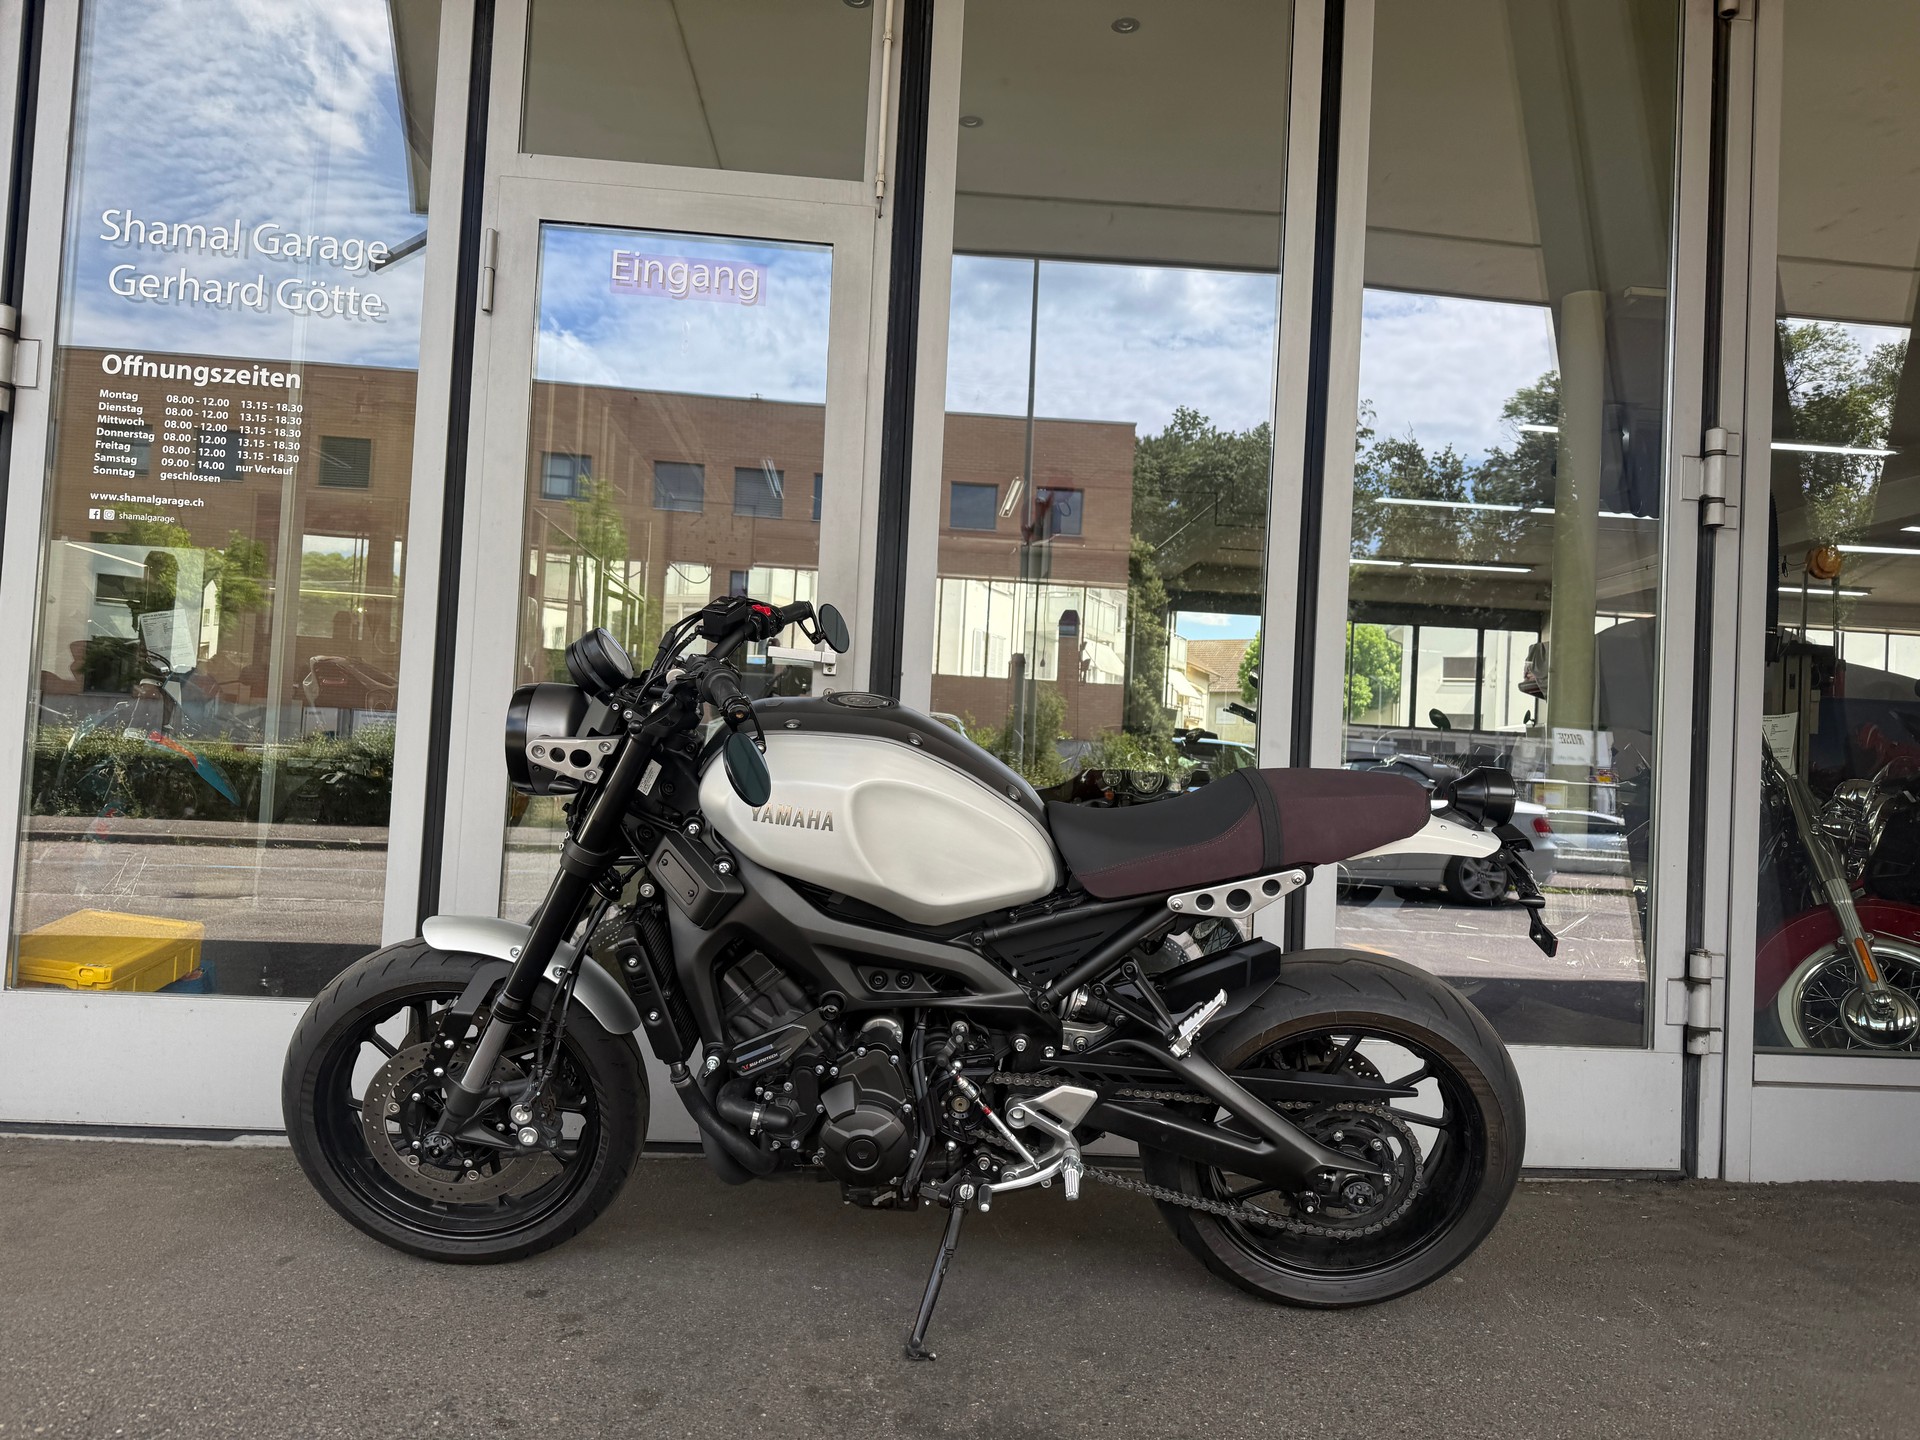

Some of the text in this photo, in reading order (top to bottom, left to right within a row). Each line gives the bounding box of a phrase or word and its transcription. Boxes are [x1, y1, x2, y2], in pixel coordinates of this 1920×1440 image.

[100, 209, 389, 271] Shamal Garage
[612, 249, 759, 300] Eingang
[108, 264, 383, 317] Gerhard Götte
[100, 389, 139, 402] Montag
[166, 394, 194, 404] 08.00
[202, 398, 229, 407] 12.00
[241, 400, 268, 410] 13.15
[276, 403, 303, 413] 18.30
[99, 402, 143, 414] Dienstag
[165, 408, 193, 417] 08.00
[202, 411, 228, 420] 12.00
[240, 413, 267, 423] 13.15
[275, 416, 302, 425] 18.30
[97, 415, 144, 426] Mittwoch
[164, 420, 192, 429] 08.00
[200, 423, 228, 432] 12.00
[239, 426, 266, 435] 13.15
[275, 429, 301, 438] 18.30
[96, 428, 155, 442] Donnerstag
[163, 433, 191, 442] 08.00
[199, 436, 226, 445] 12.00
[238, 439, 265, 448] 13.15
[274, 441, 300, 450] 18.30
[95, 440, 131, 452] Freitag
[162, 445, 190, 455] 08.00
[199, 448, 226, 458] 12.00
[237, 451, 264, 460] 13.15
[273, 454, 299, 463] 18.30
[93, 466, 220, 483] Sonntag geschlossen
[94, 453, 137, 465] Samstag
[161, 458, 189, 468] 09.00
[197, 461, 225, 471] 14.00
[236, 465, 253, 473] nur
[255, 466, 293, 475] Verkauf
[90, 492, 204, 507] www.shamalgarage.ch
[119, 512, 175, 523] shamalgarage
[752, 803, 833, 831] YAMAHA
